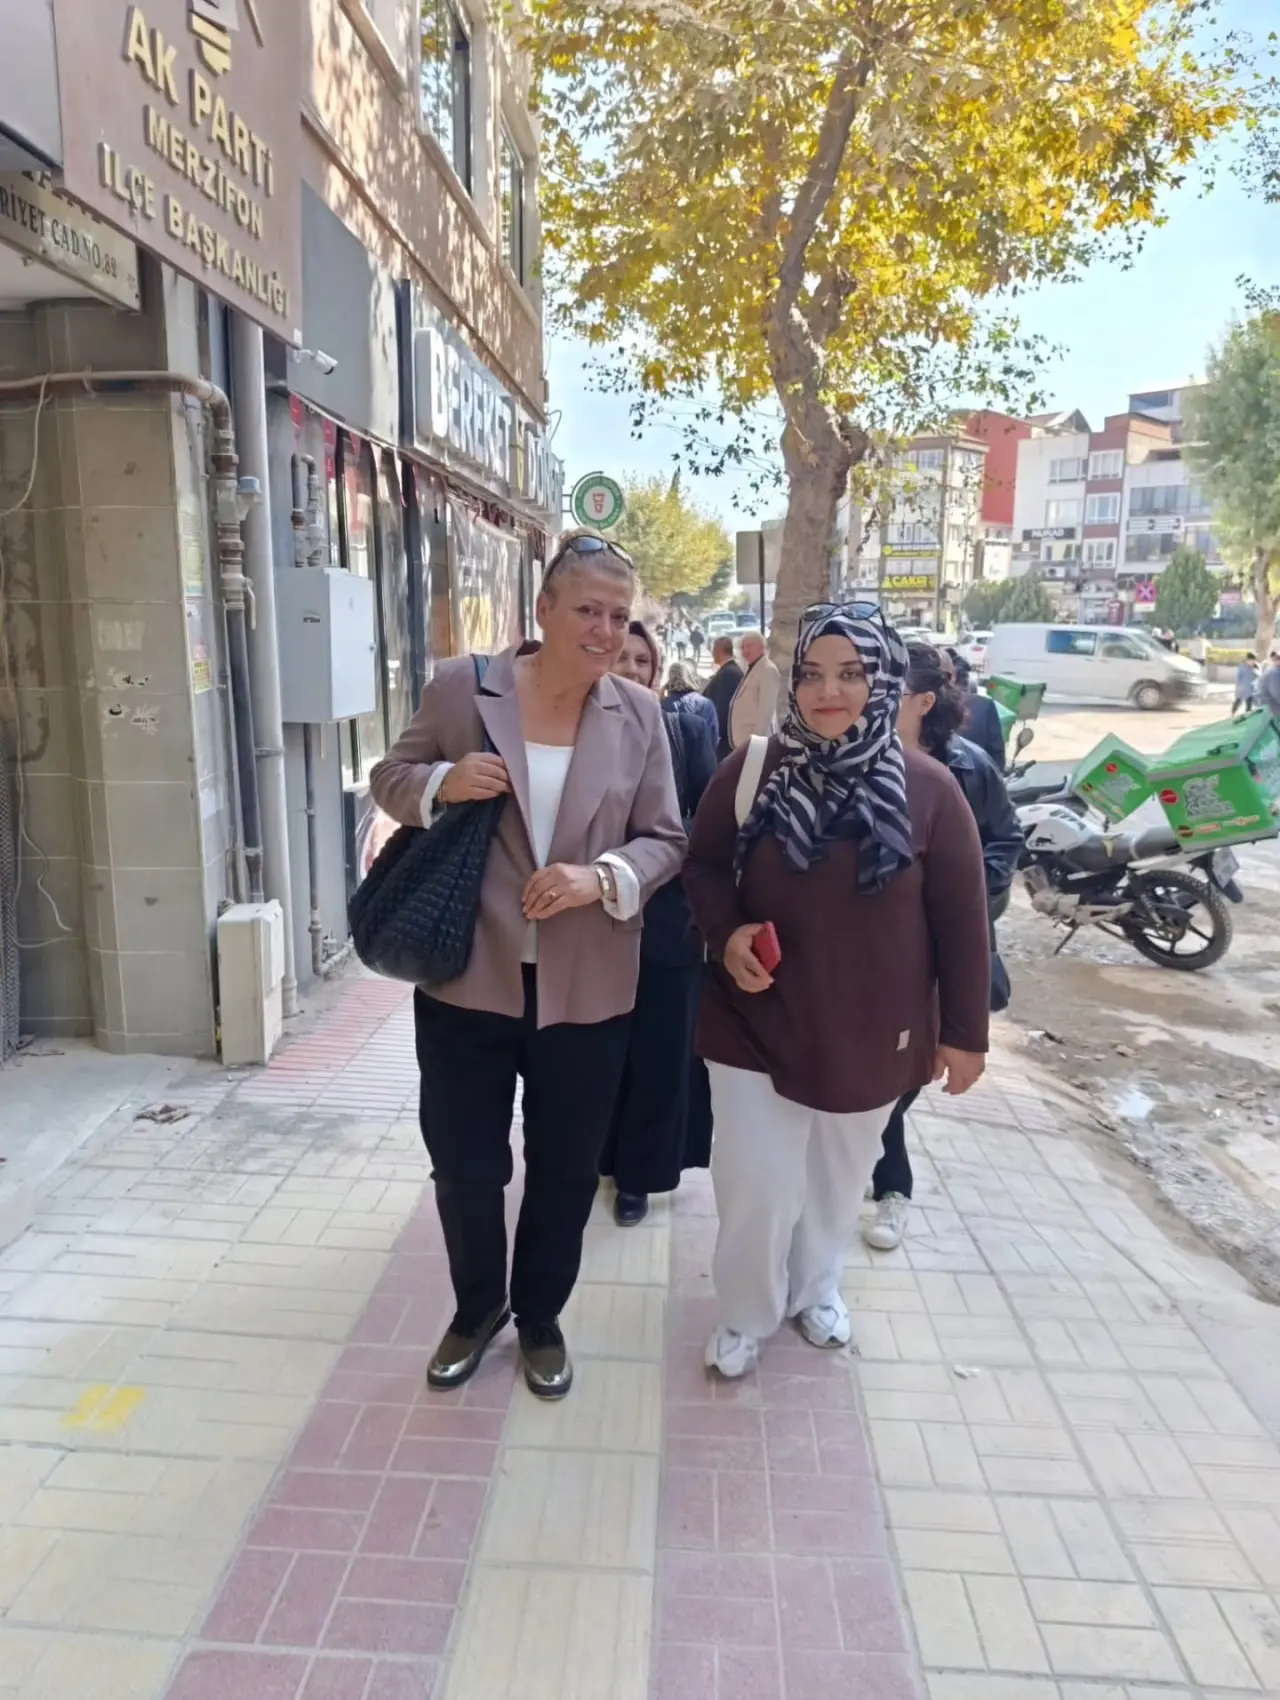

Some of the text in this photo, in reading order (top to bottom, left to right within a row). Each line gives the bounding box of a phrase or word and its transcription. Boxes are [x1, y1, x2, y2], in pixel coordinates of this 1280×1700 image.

[123, 4, 274, 197] AK PARTİ
[144, 104, 263, 240] MERZİFON
